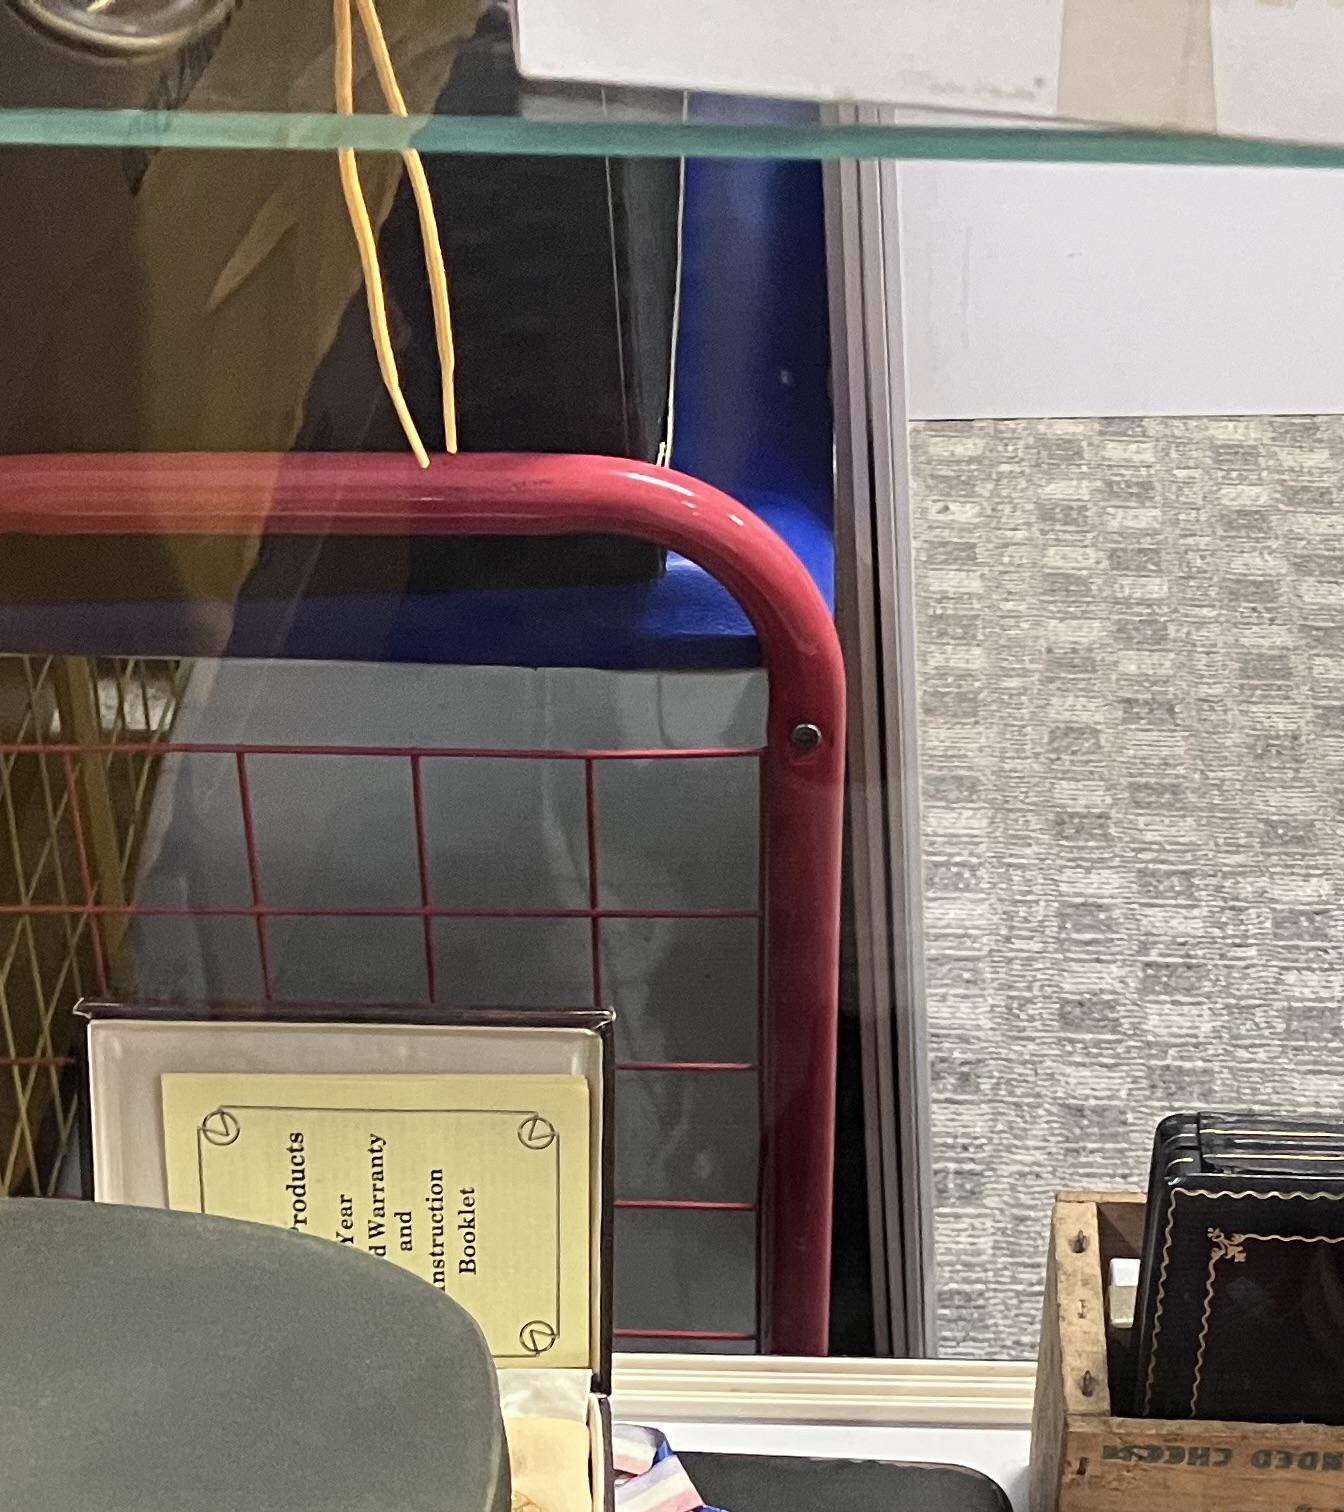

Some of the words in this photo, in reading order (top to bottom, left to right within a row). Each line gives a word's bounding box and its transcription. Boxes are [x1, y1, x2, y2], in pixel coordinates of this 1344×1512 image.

[368, 1133, 386, 1239] Warranty
[394, 1211, 412, 1251] and
[458, 1187, 476, 1275] Booklet
